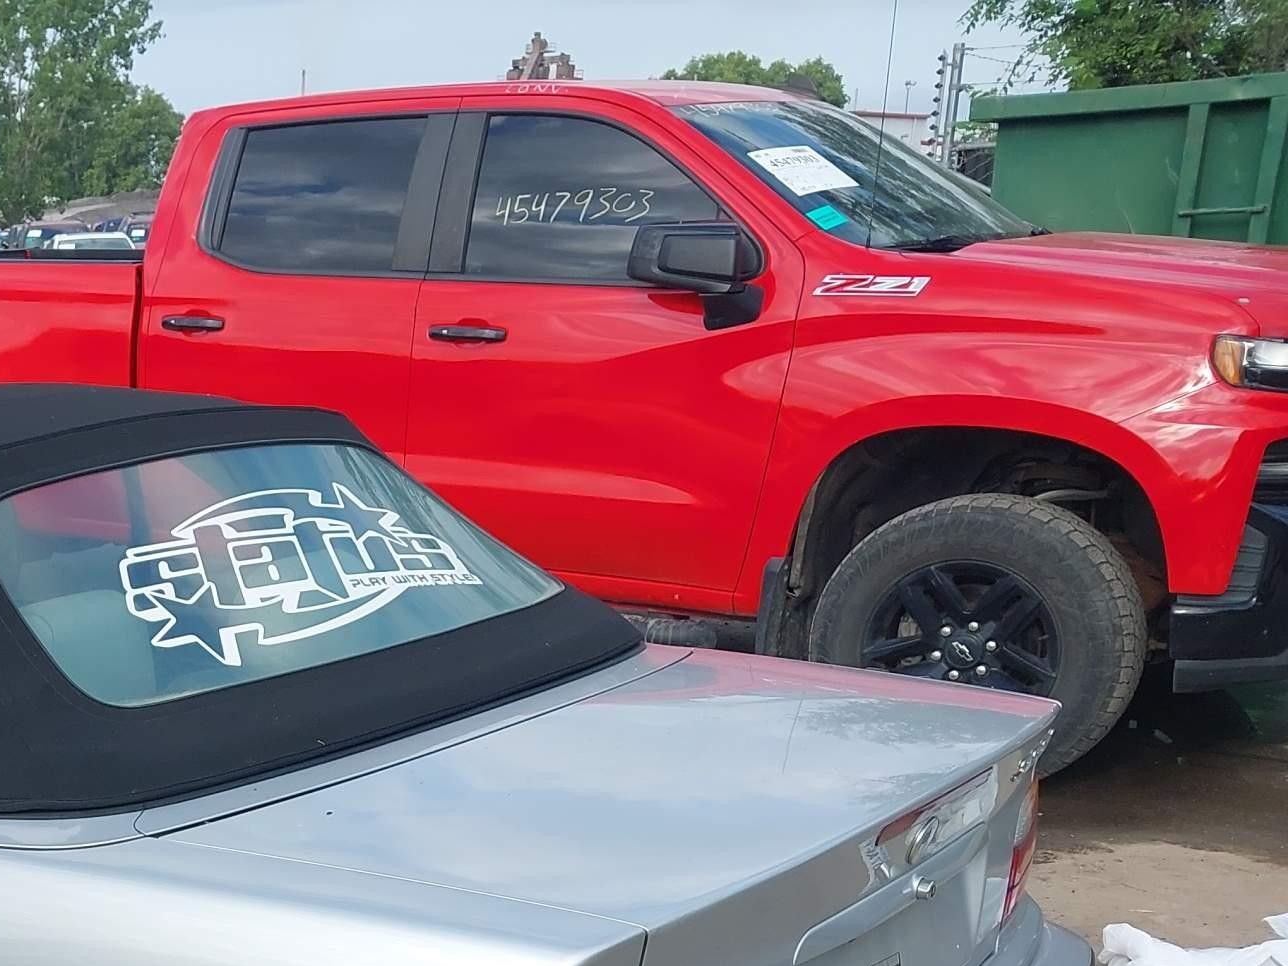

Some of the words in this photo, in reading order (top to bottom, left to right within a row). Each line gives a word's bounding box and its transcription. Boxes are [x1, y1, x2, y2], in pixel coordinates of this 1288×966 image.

[495, 187, 655, 226] 45479303
[811, 274, 932, 297] Z71
[348, 575, 388, 588] PLAY
[392, 573, 426, 585] WITH
